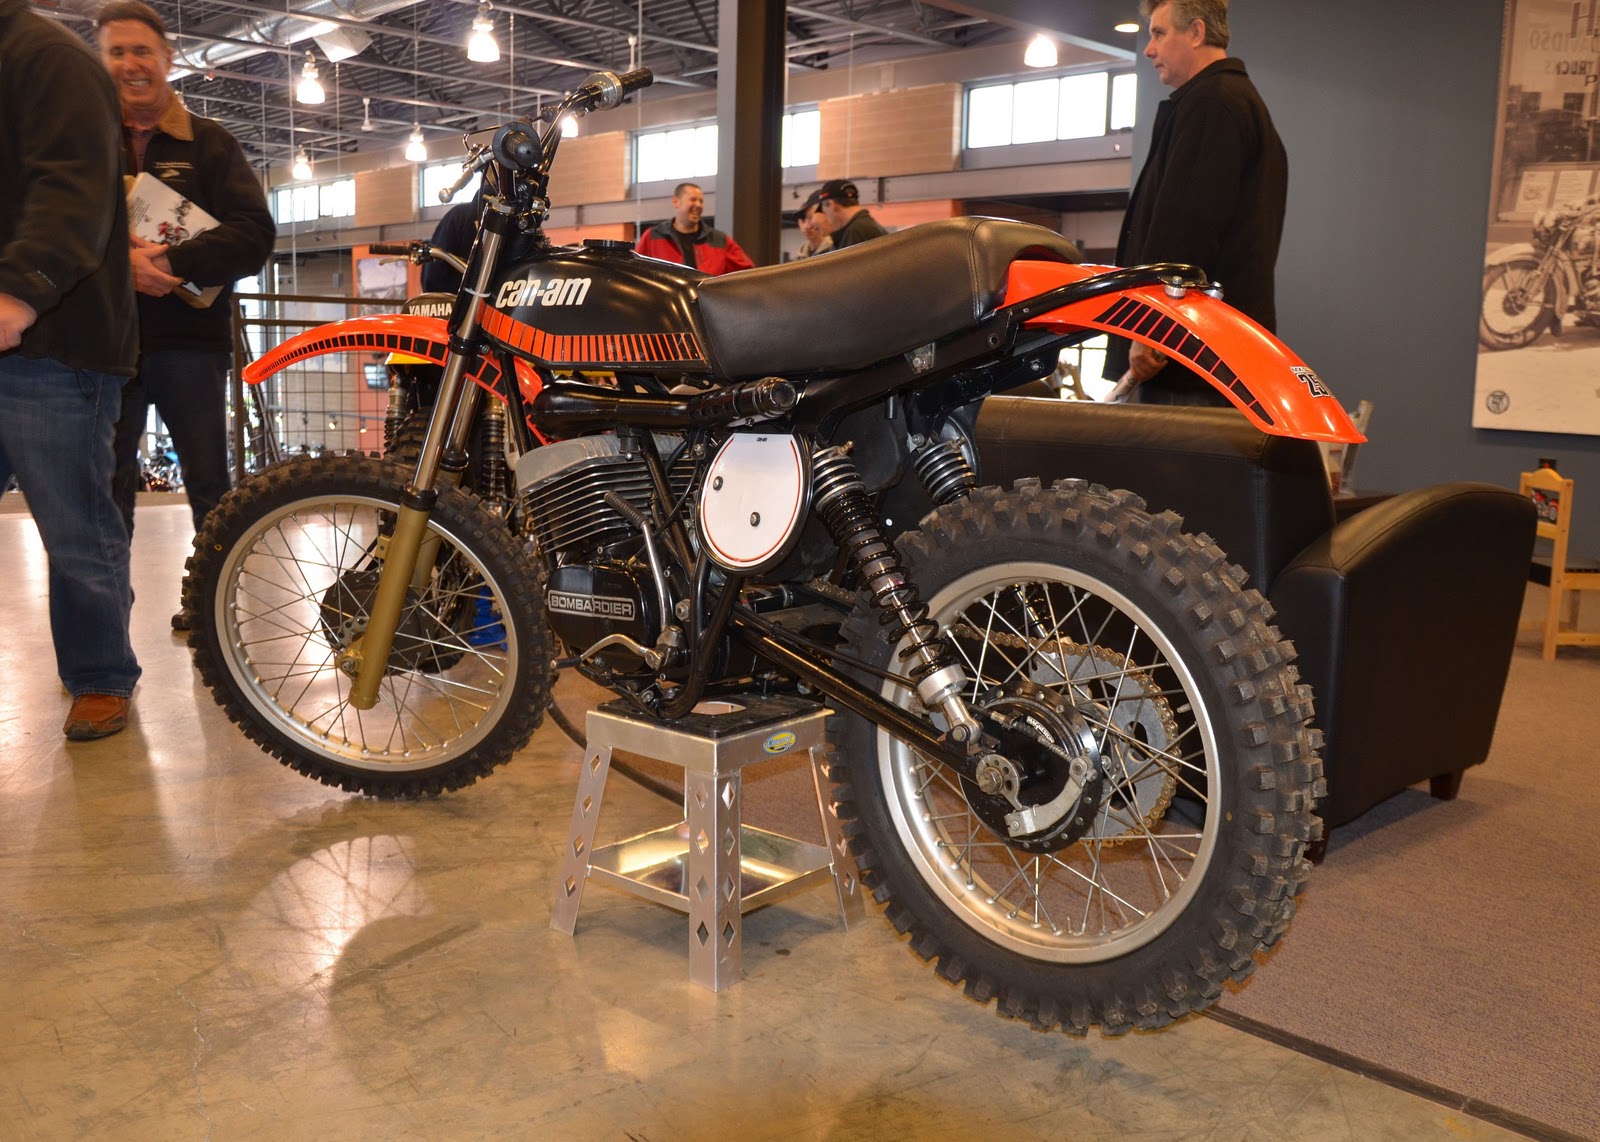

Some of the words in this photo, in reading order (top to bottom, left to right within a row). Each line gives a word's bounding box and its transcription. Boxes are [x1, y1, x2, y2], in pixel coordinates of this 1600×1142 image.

[495, 277, 592, 309] can-am
[408, 302, 453, 317] YAMAHA
[550, 594, 632, 616] BOMBARDIER
